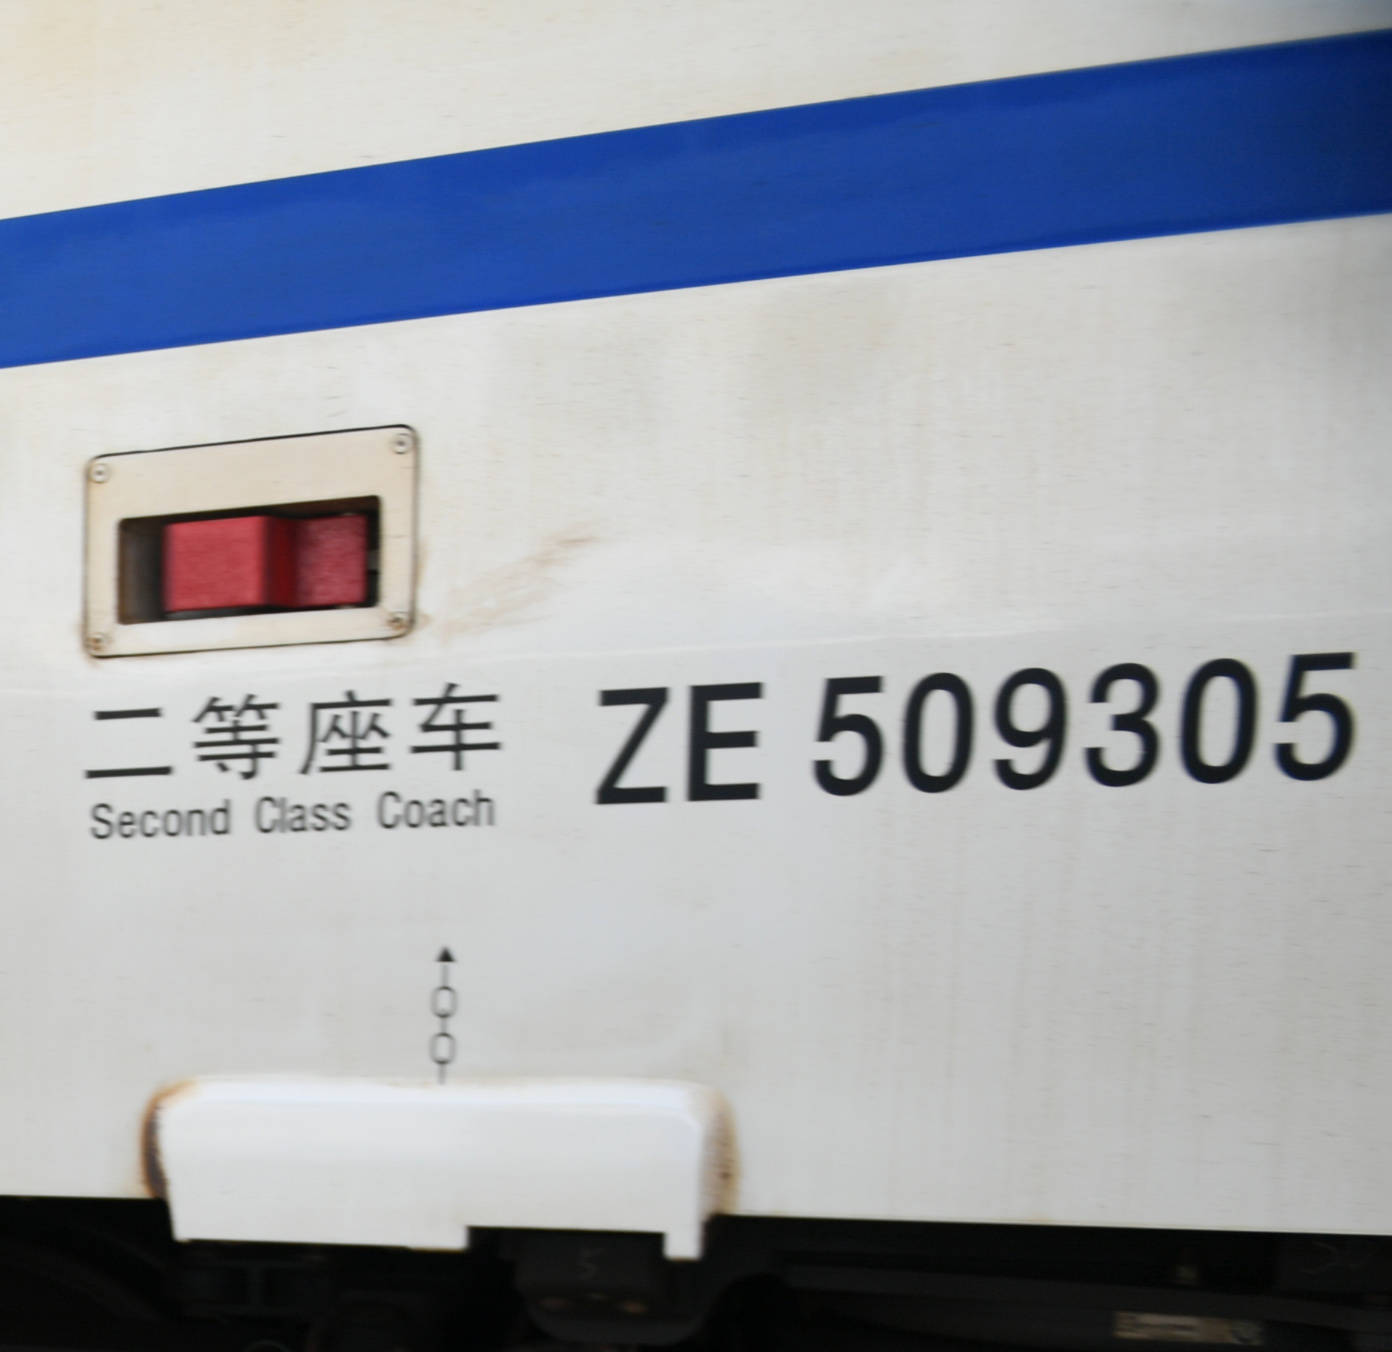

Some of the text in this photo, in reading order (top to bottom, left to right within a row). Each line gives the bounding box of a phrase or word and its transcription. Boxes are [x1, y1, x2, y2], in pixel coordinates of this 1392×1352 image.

[84, 681, 503, 782] 二等座车
[594, 650, 1358, 805] ZE 509305
[90, 790, 496, 841] Second Class Coach
